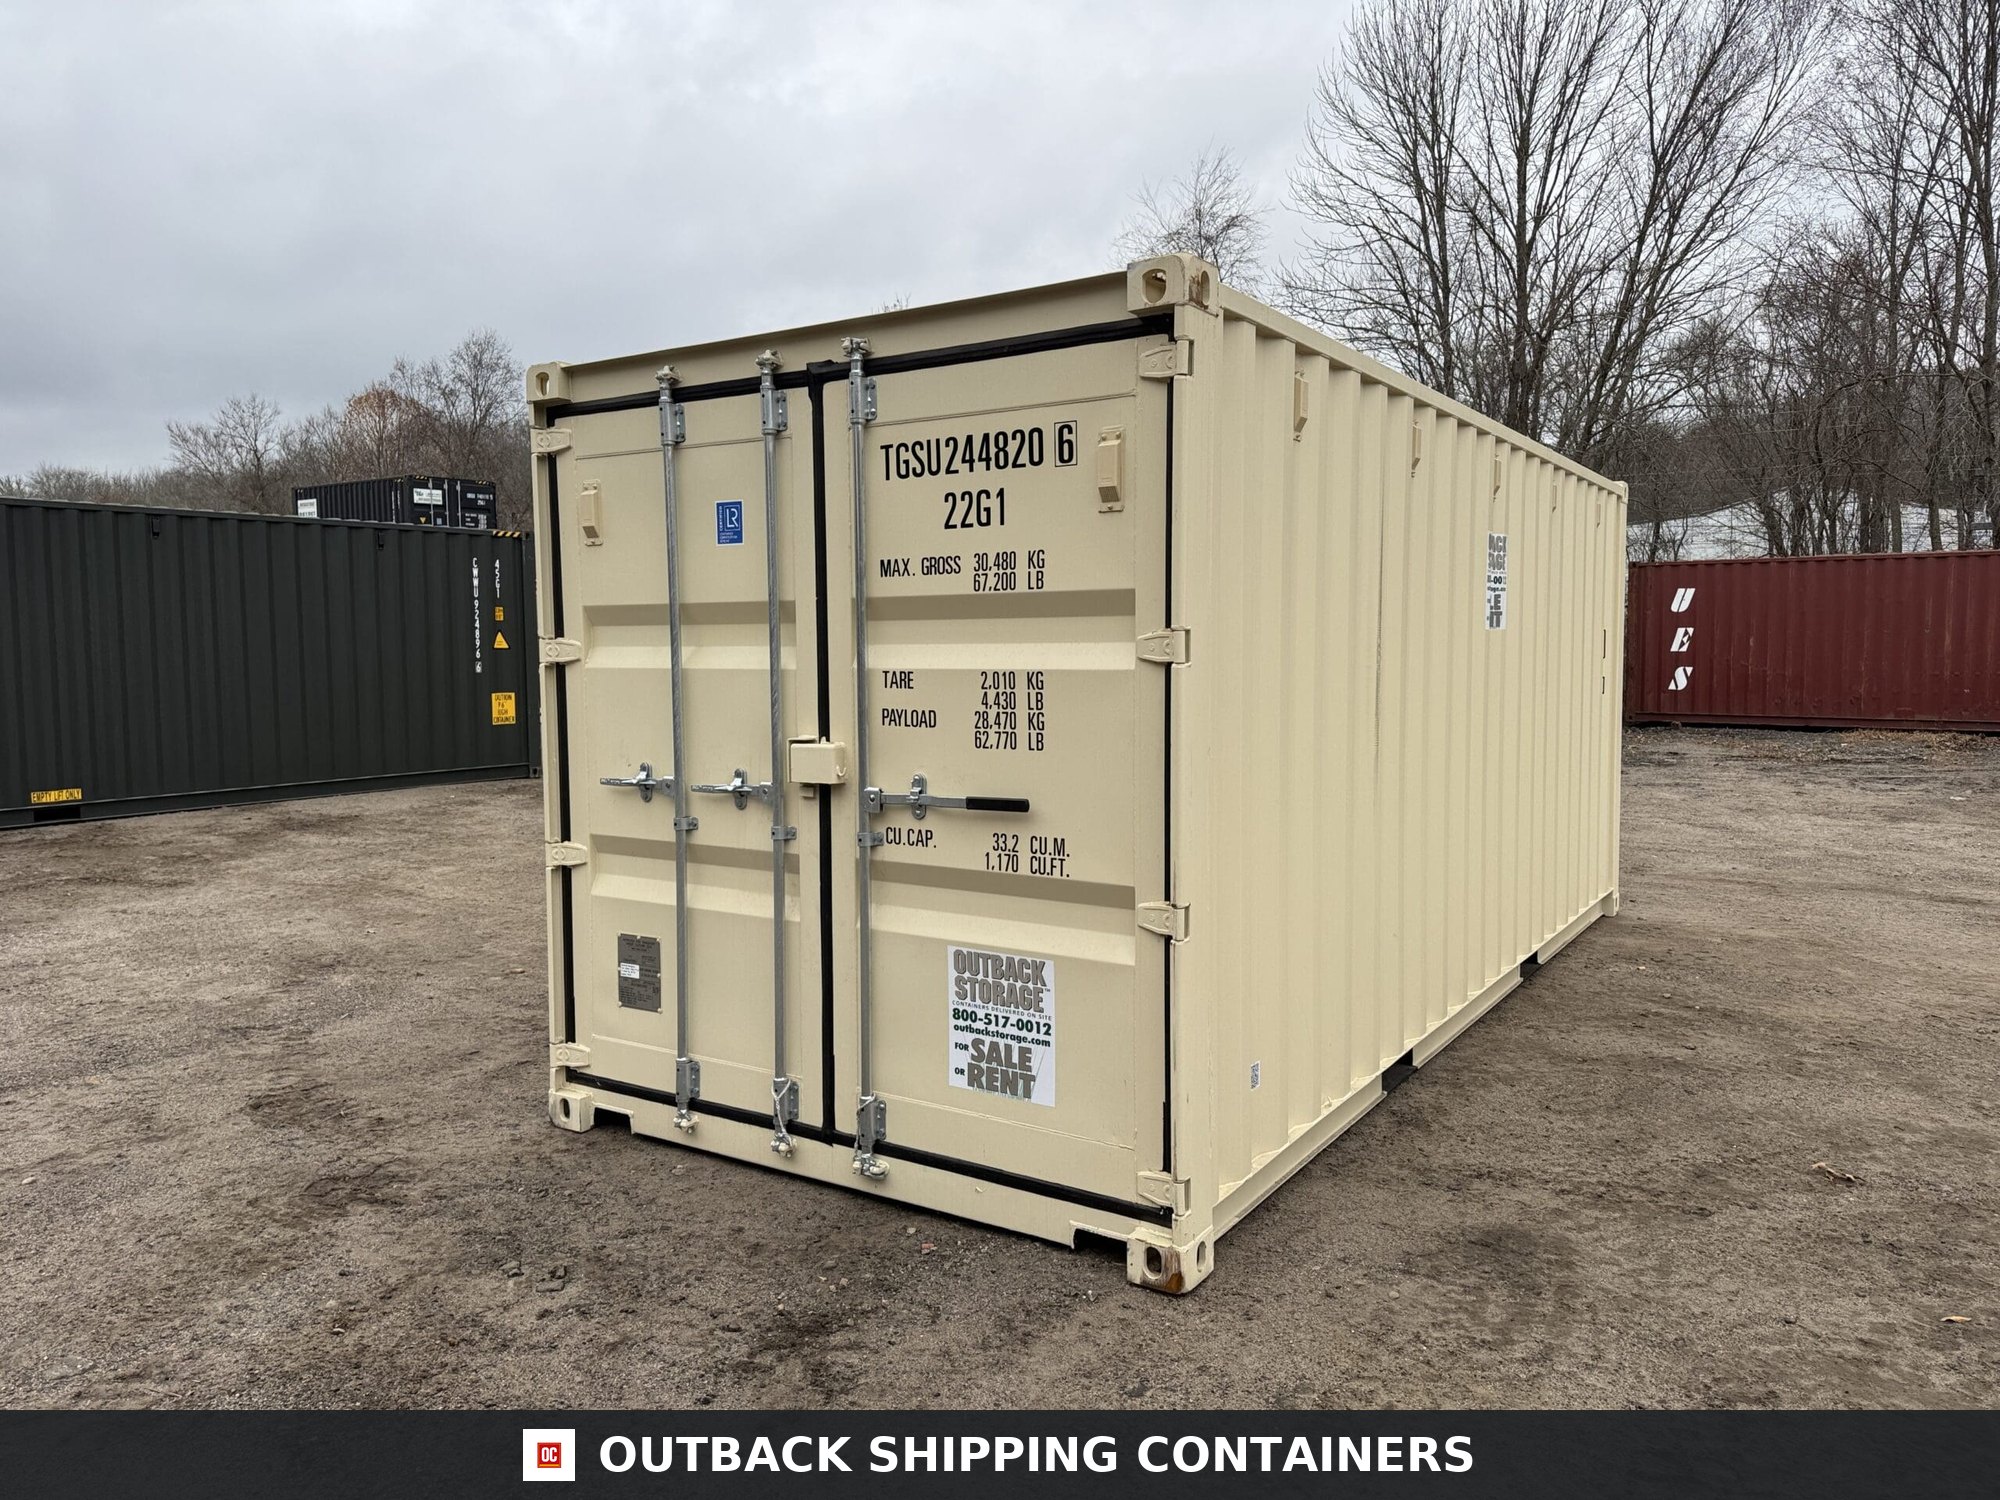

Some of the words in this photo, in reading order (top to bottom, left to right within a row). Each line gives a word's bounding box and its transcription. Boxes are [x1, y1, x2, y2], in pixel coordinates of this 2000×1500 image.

[880, 427, 1044, 481] TGSU244820
[1057, 423, 1075, 465] 6
[944, 487, 1006, 530] 22G1
[471, 557, 479, 598] CWWU
[880, 558, 916, 578] MAX.
[921, 555, 962, 576] GROSS
[973, 551, 1017, 572] 30,480
[1027, 549, 1046, 570] KG
[973, 571, 1017, 592] 67,200
[1027, 570, 1045, 591] LB
[882, 670, 915, 690] TARE
[980, 671, 1017, 691] 2,010
[1026, 671, 1045, 691] KG
[981, 691, 1017, 711] 4,430
[1027, 691, 1044, 711] LB
[881, 708, 937, 729] PAYLOAD
[974, 711, 1018, 731] 28,470
[1027, 711, 1046, 732] KG
[974, 730, 1018, 750] 62,770
[1027, 731, 1045, 752] LB
[885, 826, 937, 849] CU.CAP.
[992, 833, 1020, 853] 33.2
[1030, 836, 1071, 858] CU.M.
[984, 852, 1020, 873] 1,170
[1030, 857, 1071, 878] CU.FT.
[953, 949, 1047, 988] OUTBACK
[952, 1000, 990, 1011] CONTAINERS
[991, 1006, 1025, 1018] DELIVERED
[952, 1008, 1052, 1037] 800-517-0012
[953, 1024, 1051, 1048] outbackstorage.com
[954, 1042, 970, 1052] FOR
[970, 1038, 1033, 1073] SALE
[954, 1067, 966, 1077] OR
[967, 1063, 1036, 1100] RENT
